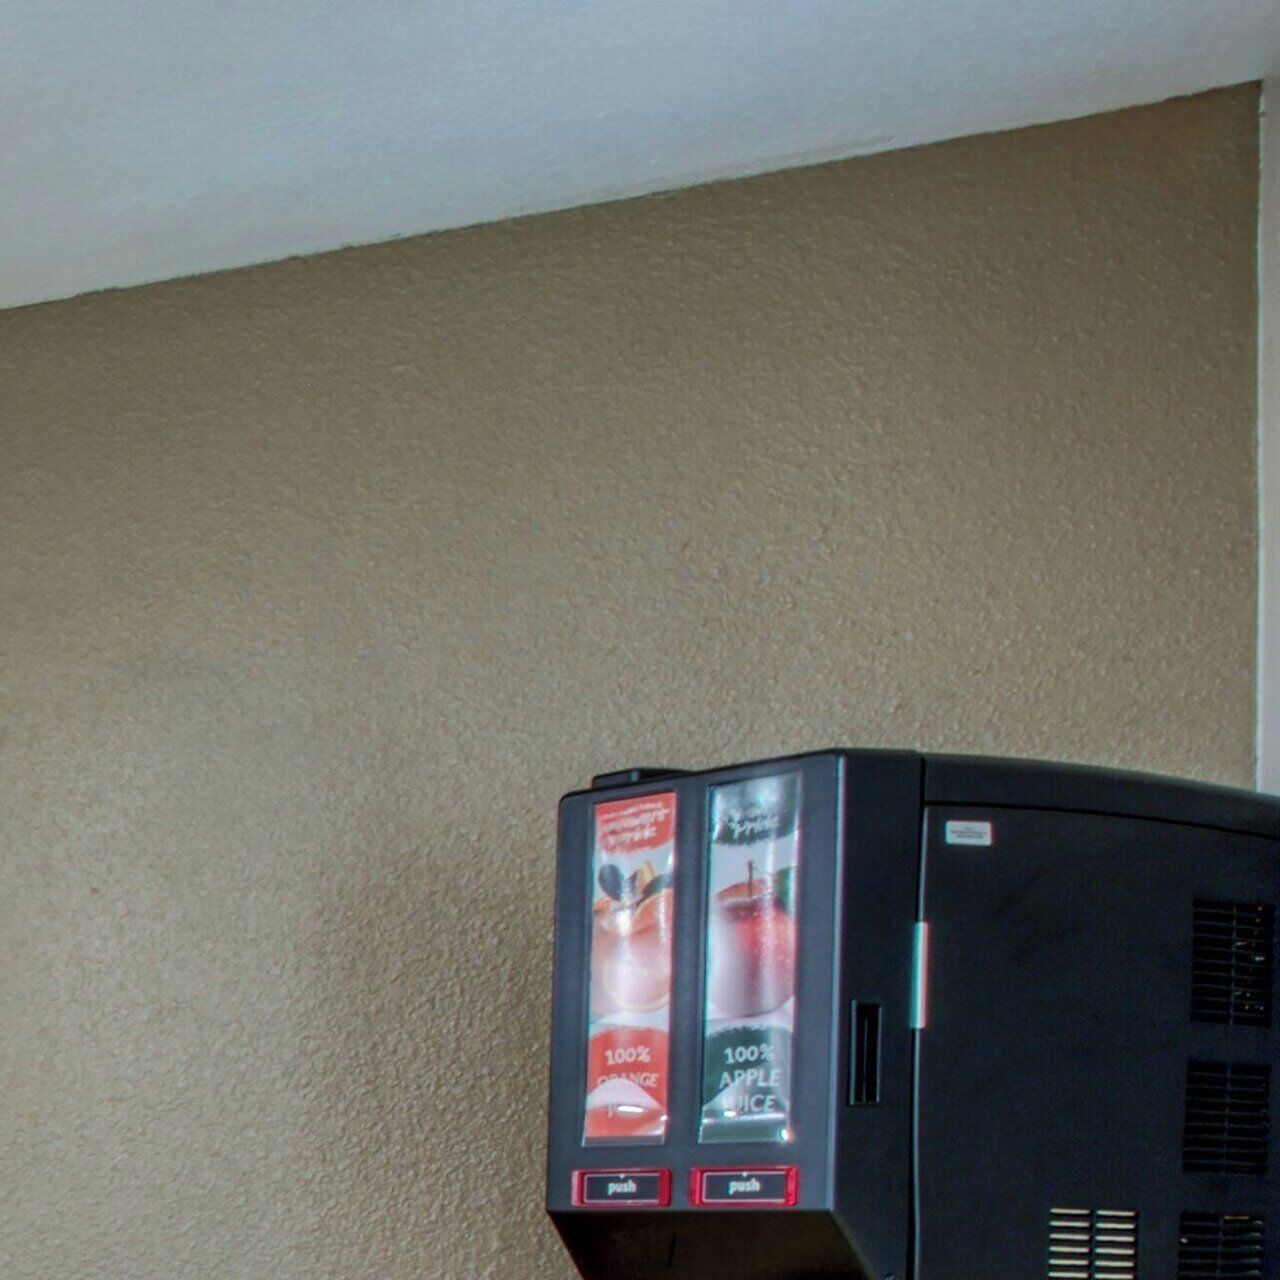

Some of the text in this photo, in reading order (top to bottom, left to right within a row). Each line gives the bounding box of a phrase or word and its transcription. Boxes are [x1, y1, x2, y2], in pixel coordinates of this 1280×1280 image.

[604, 1046, 651, 1066] 100%
[724, 1045, 774, 1065] 100%
[718, 1068, 781, 1088] APPLE
[607, 1179, 637, 1196] push
[728, 1178, 760, 1195] push
